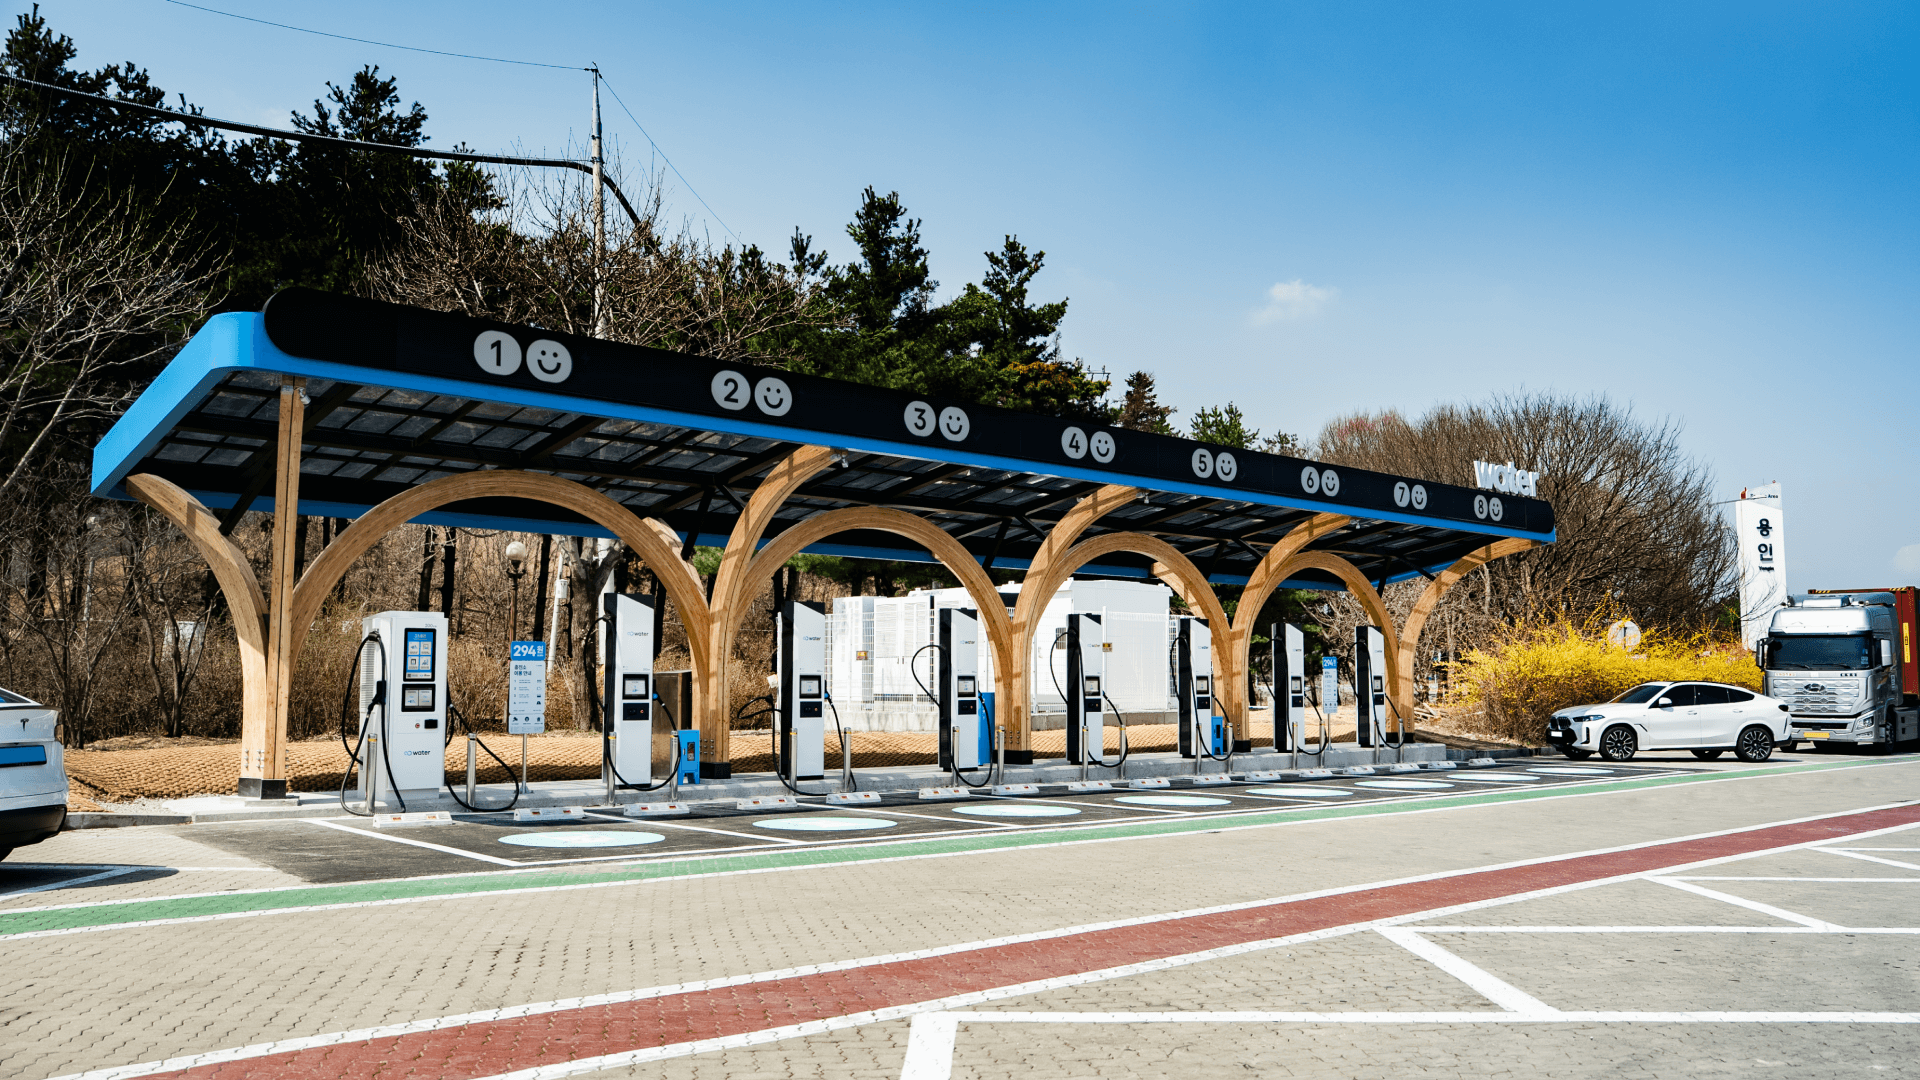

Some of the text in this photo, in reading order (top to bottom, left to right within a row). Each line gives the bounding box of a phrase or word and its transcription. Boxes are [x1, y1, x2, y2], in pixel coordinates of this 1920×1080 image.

[490, 339, 502, 367] 1
[723, 377, 739, 404] 2
[913, 407, 927, 431] 3
[1068, 432, 1081, 454] 4
[1198, 453, 1208, 473] 5
[1306, 471, 1315, 489] 6
[1474, 461, 1540, 497] water
[1398, 486, 1406, 503] 7
[1478, 499, 1484, 515] 8
